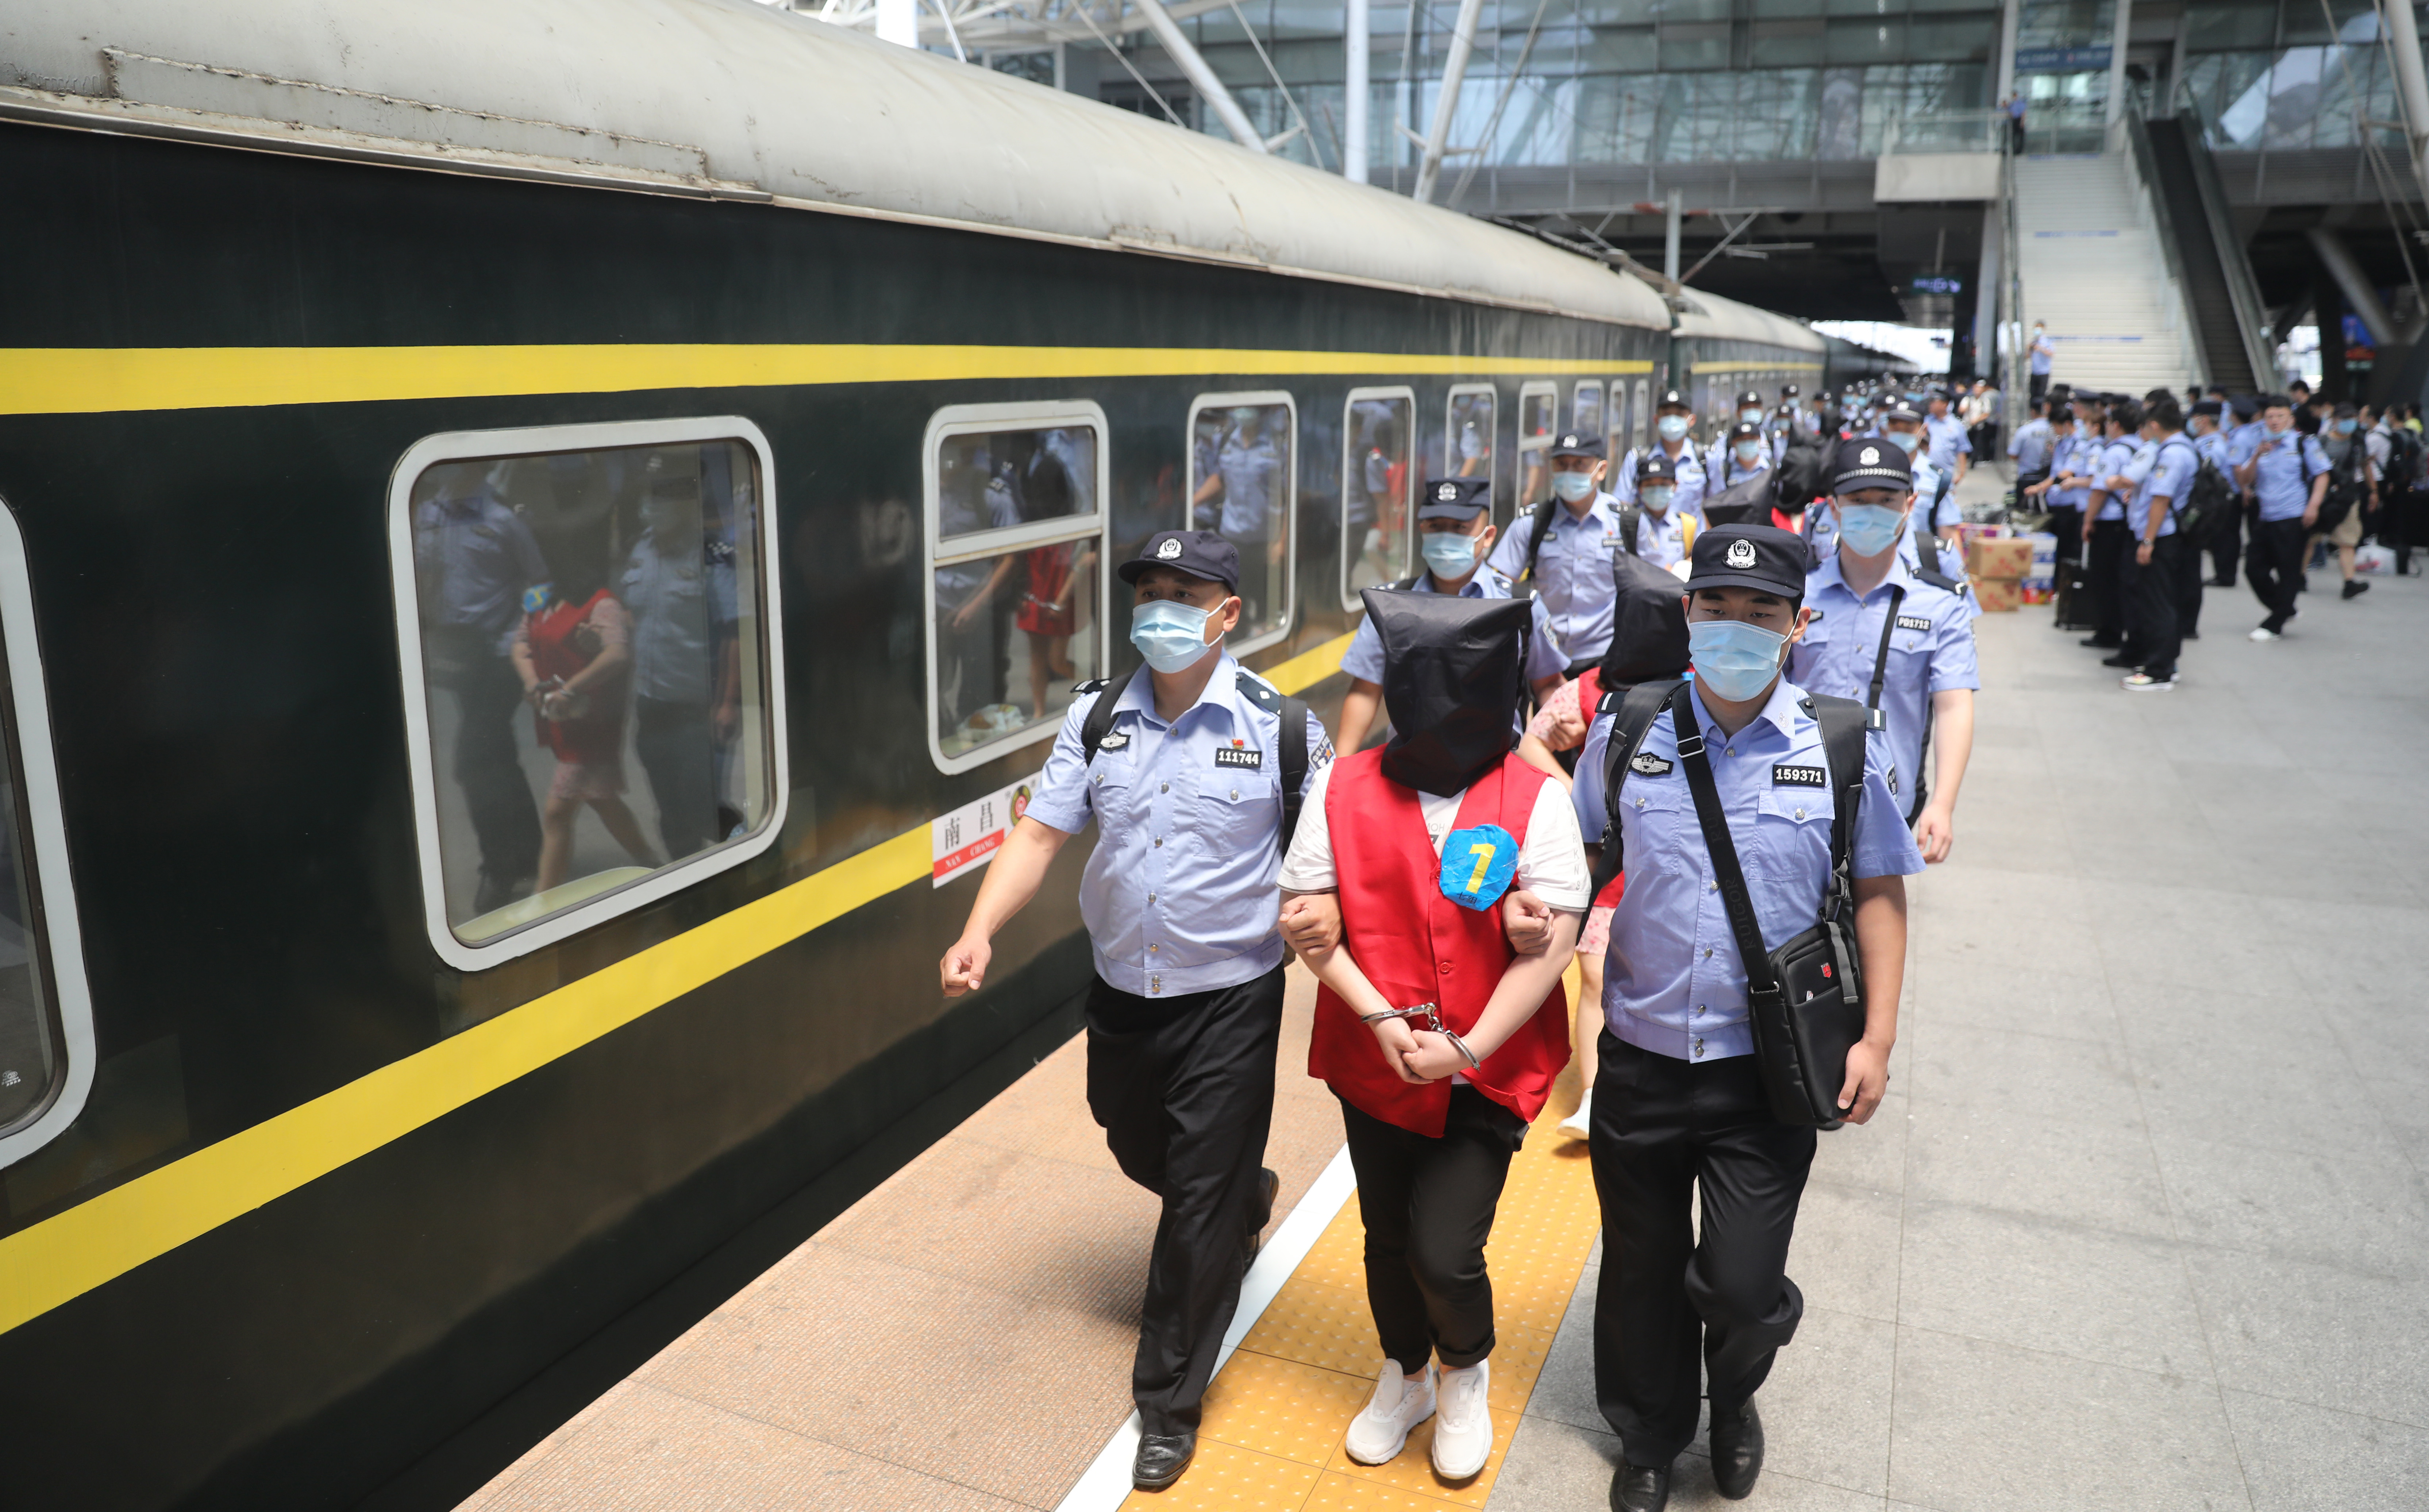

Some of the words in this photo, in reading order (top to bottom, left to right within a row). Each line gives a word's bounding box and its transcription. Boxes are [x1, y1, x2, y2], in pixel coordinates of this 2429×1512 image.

[1219, 751, 1259, 764] 111744
[1776, 768, 1822, 783] 159371
[945, 854, 961, 870] NAN
[970, 837, 995, 857] CHANG
[1725, 876, 1756, 951] RUIGOR
